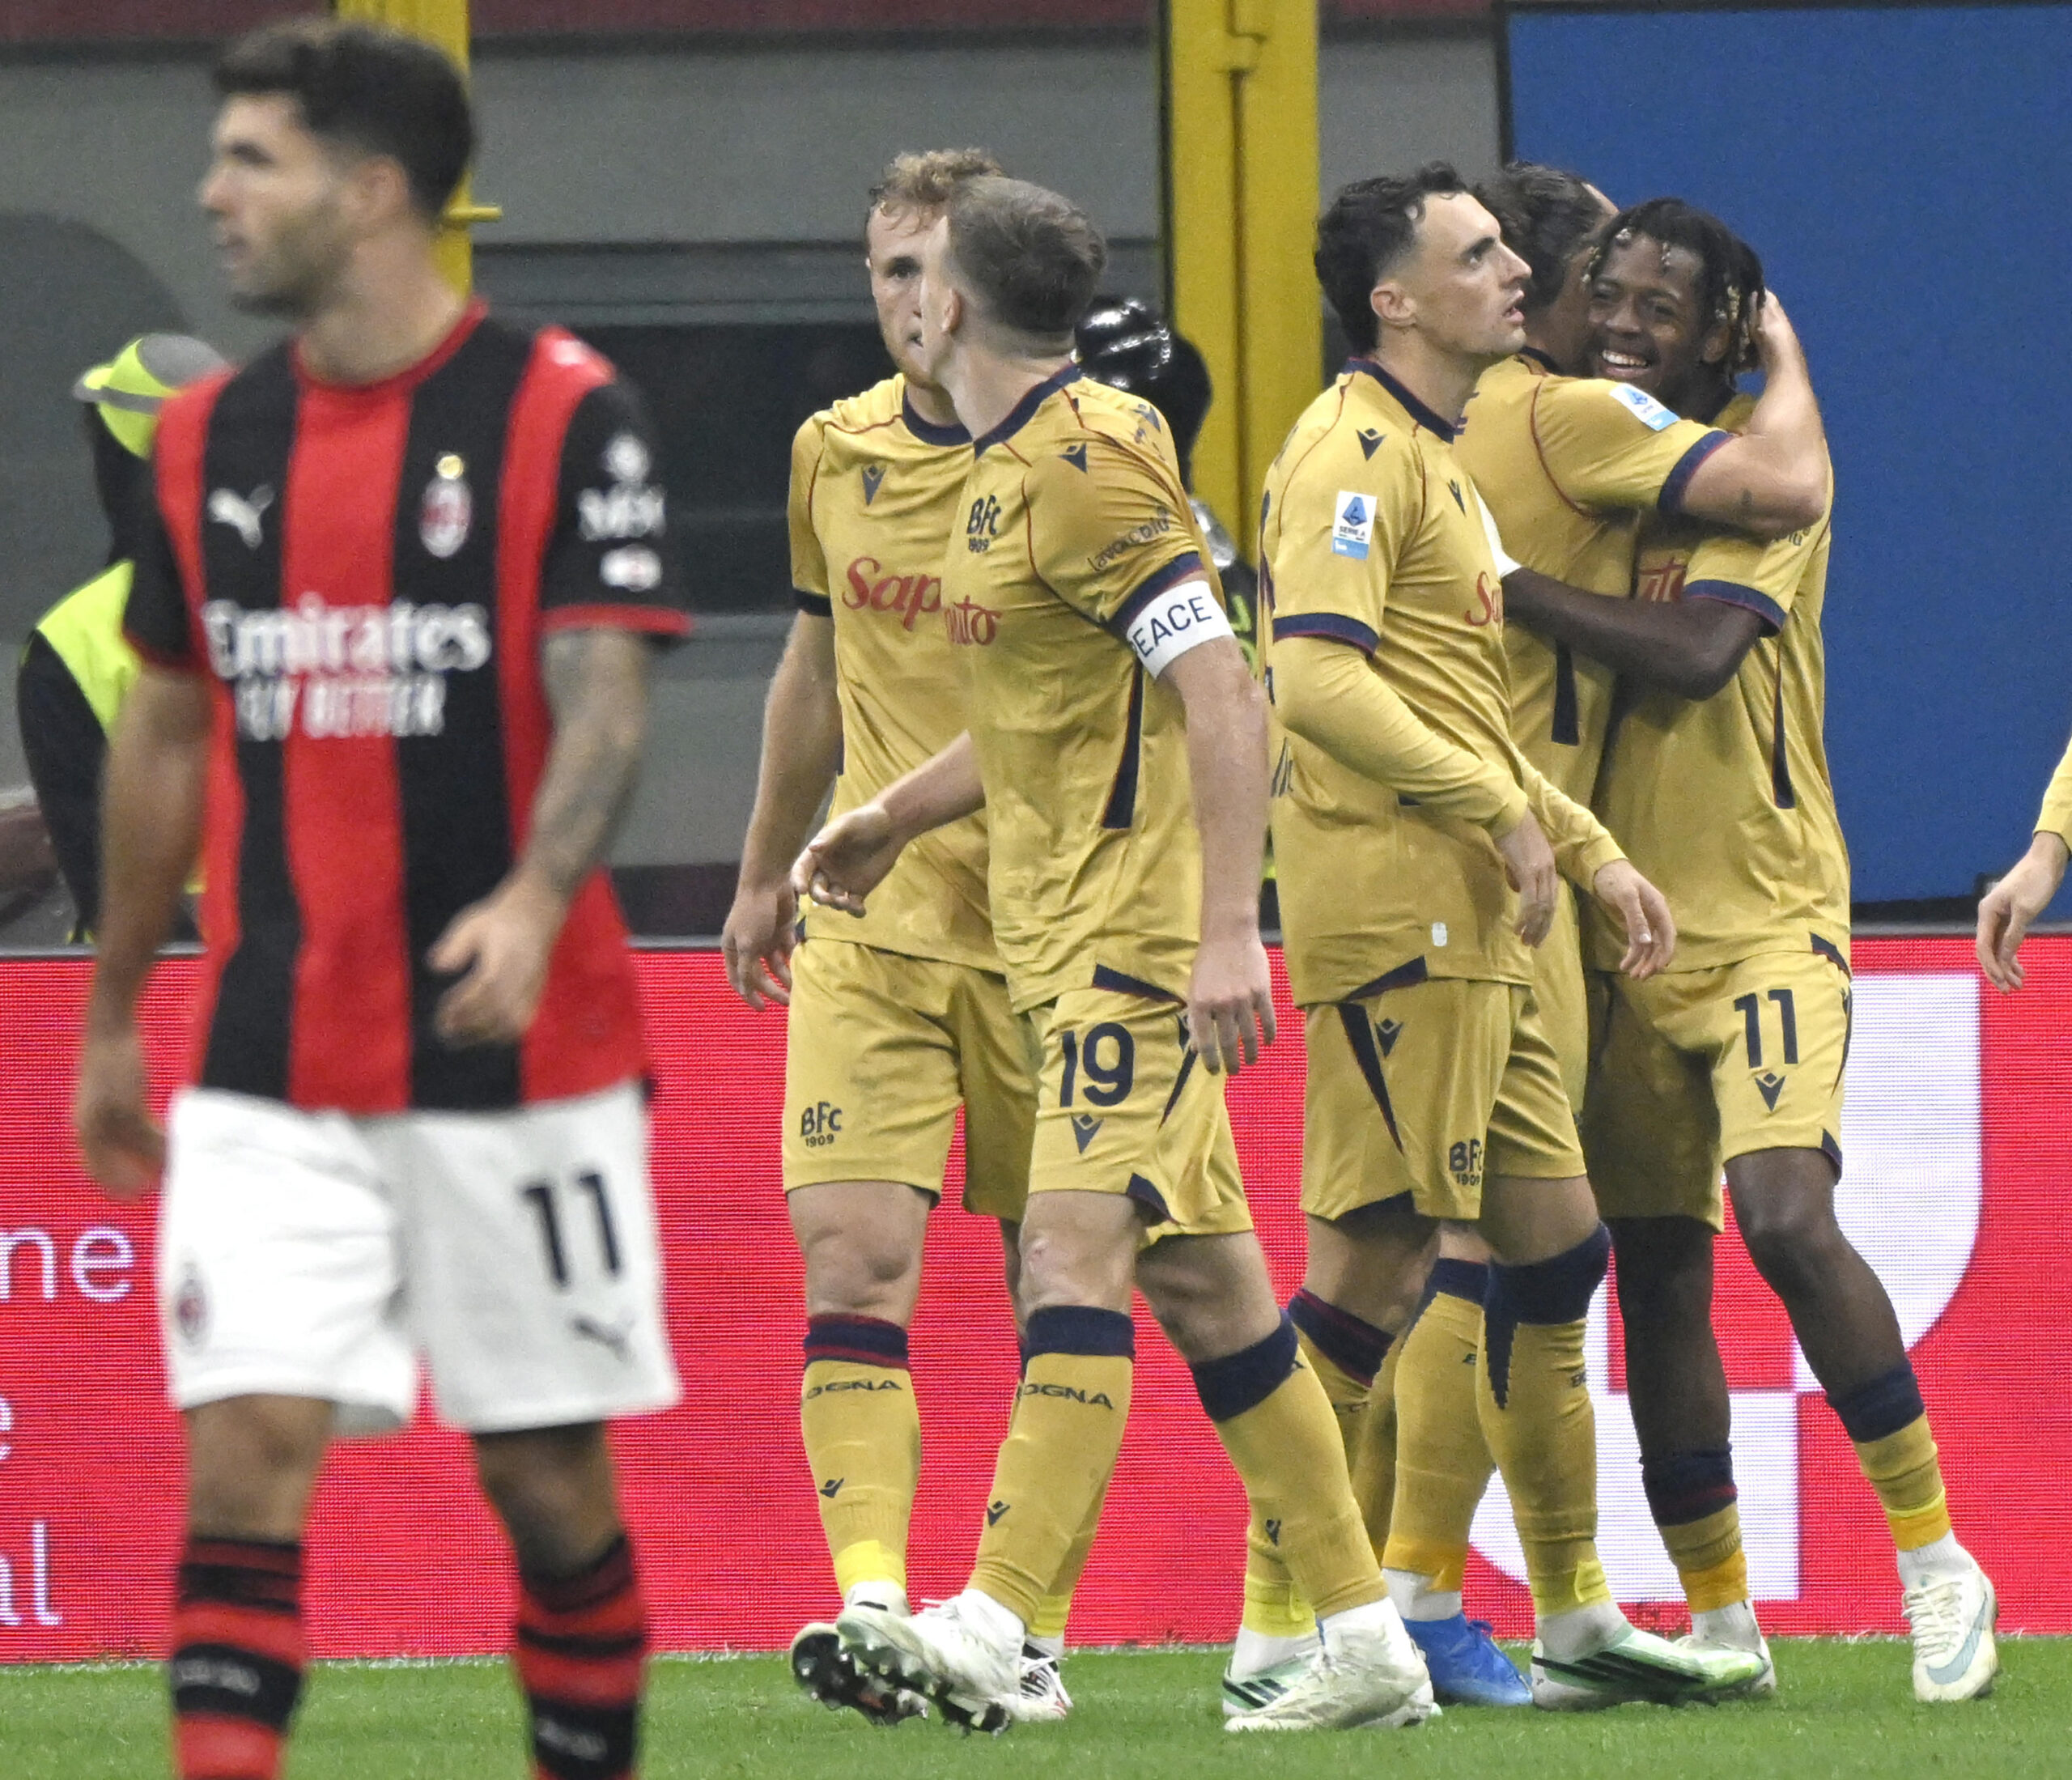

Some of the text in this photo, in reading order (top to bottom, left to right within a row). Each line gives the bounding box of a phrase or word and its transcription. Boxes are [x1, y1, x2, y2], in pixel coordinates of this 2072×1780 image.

[1059, 1022, 1135, 1107] 19
[1733, 989, 1798, 1068] 11
[800, 1102, 843, 1136] BFC
[805, 1133, 834, 1148] 1909
[519, 1170, 622, 1289] 11
